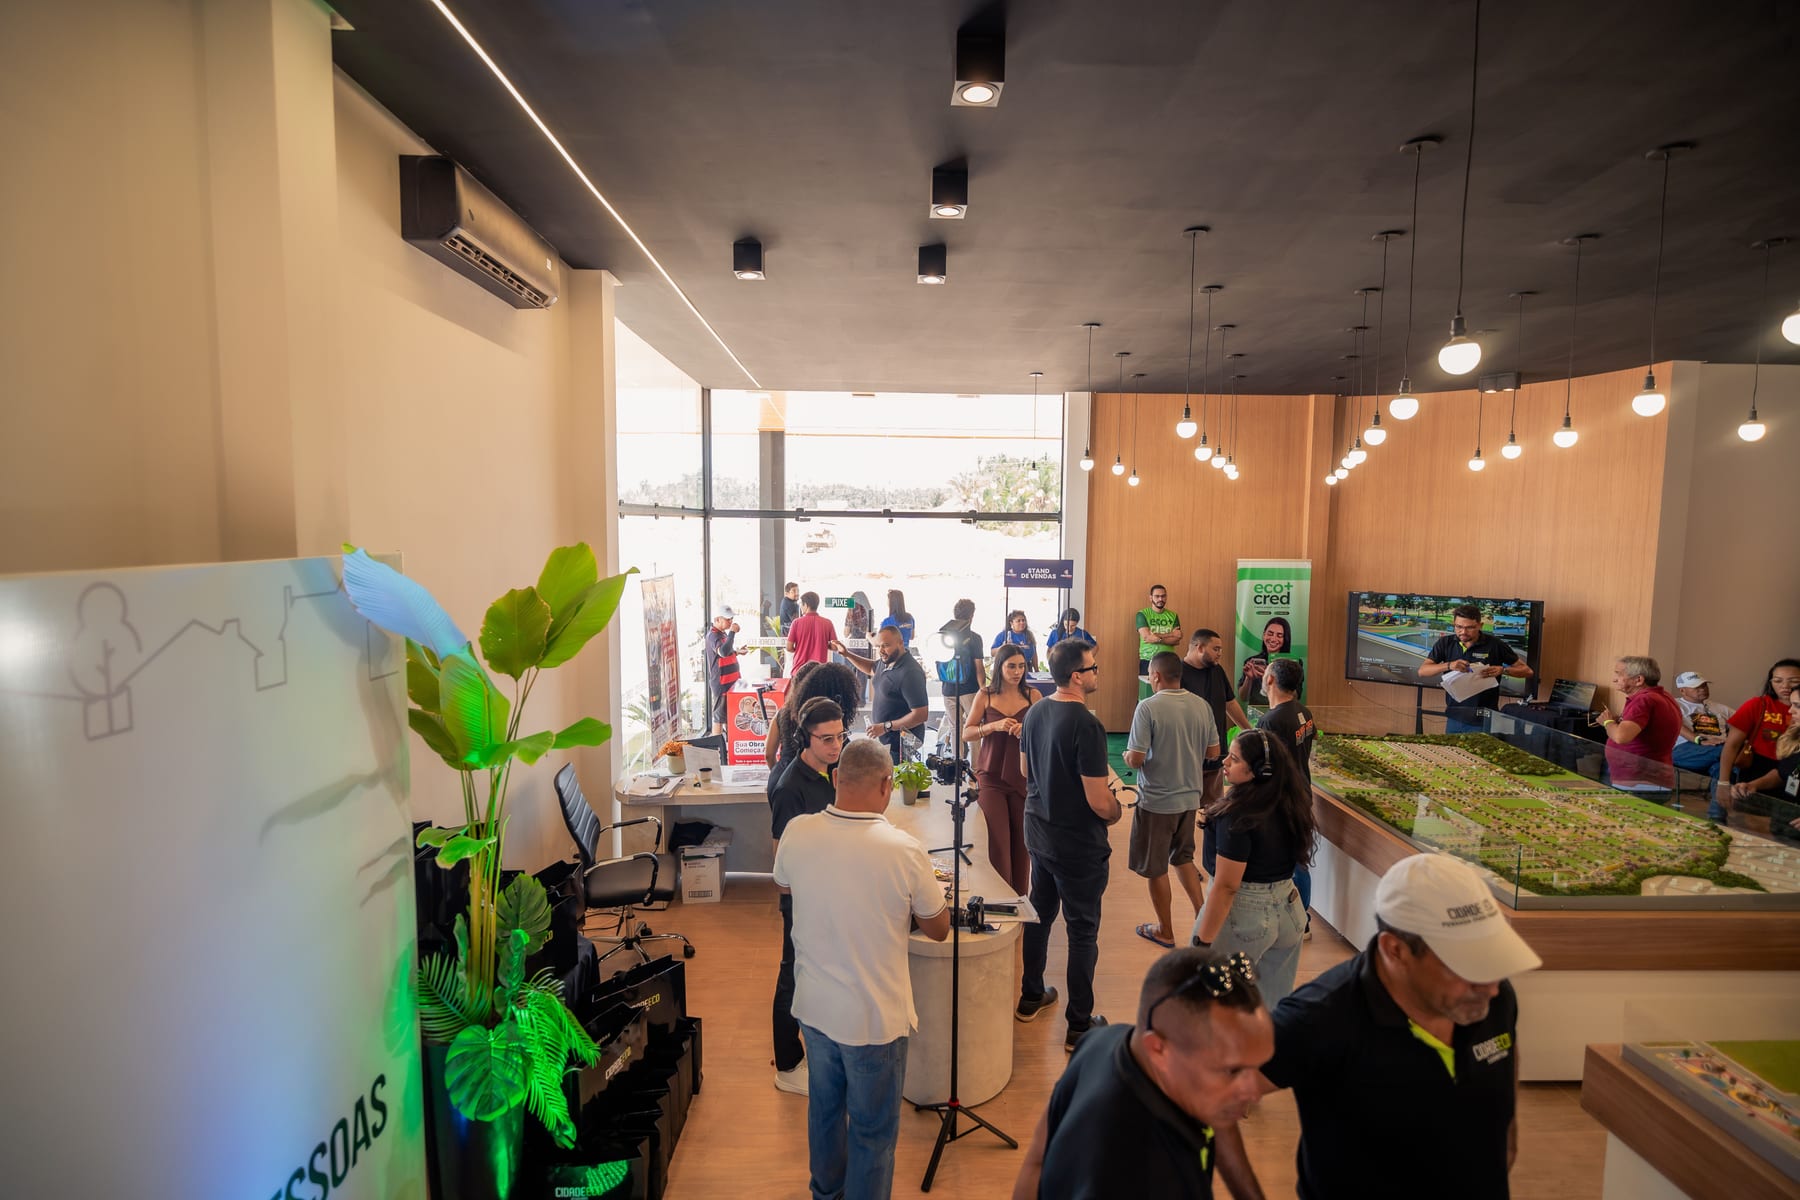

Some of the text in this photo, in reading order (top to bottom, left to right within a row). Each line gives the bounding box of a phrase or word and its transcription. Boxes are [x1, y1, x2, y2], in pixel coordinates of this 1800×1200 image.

[831, 598, 848, 607] PUXE
[1253, 592, 1291, 605] cred
[270, 1073, 388, 1200] SSOAS
